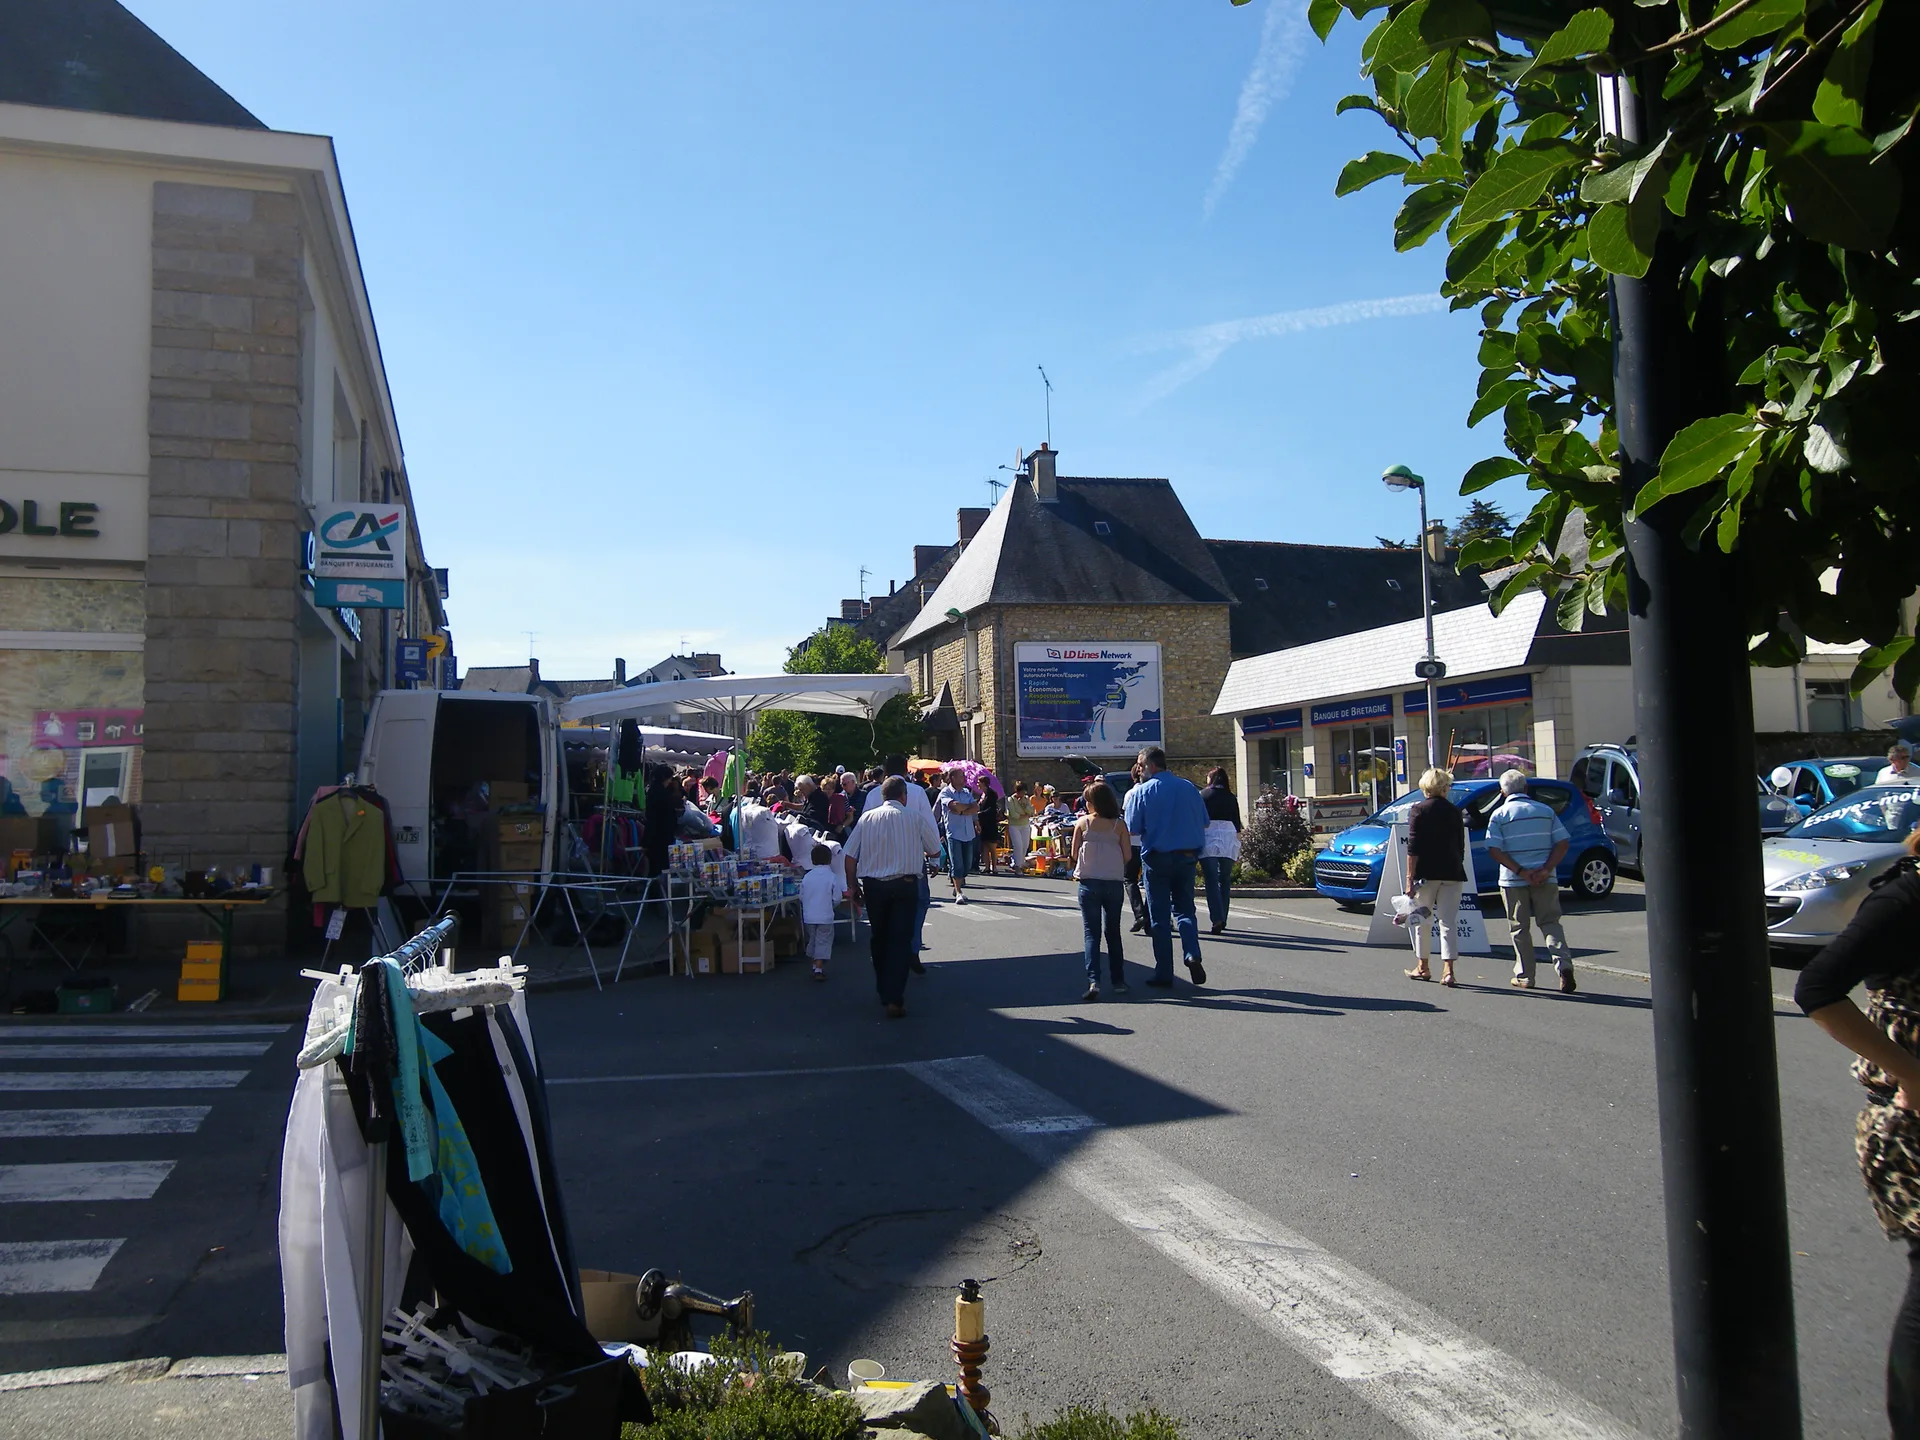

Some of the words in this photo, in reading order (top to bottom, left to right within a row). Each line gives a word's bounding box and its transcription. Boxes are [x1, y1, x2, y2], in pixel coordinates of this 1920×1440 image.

[320, 560, 346, 568] BANQUE
[355, 561, 394, 569] ASSURANCES
[1063, 650, 1076, 659] LD
[1077, 650, 1100, 659] Lines
[1100, 651, 1132, 659] Network
[1313, 710, 1339, 721] BANQUE
[1340, 709, 1349, 717] DE
[1351, 704, 1387, 716] BRETAGNE
[1803, 786, 1920, 829] Essayez-moi
